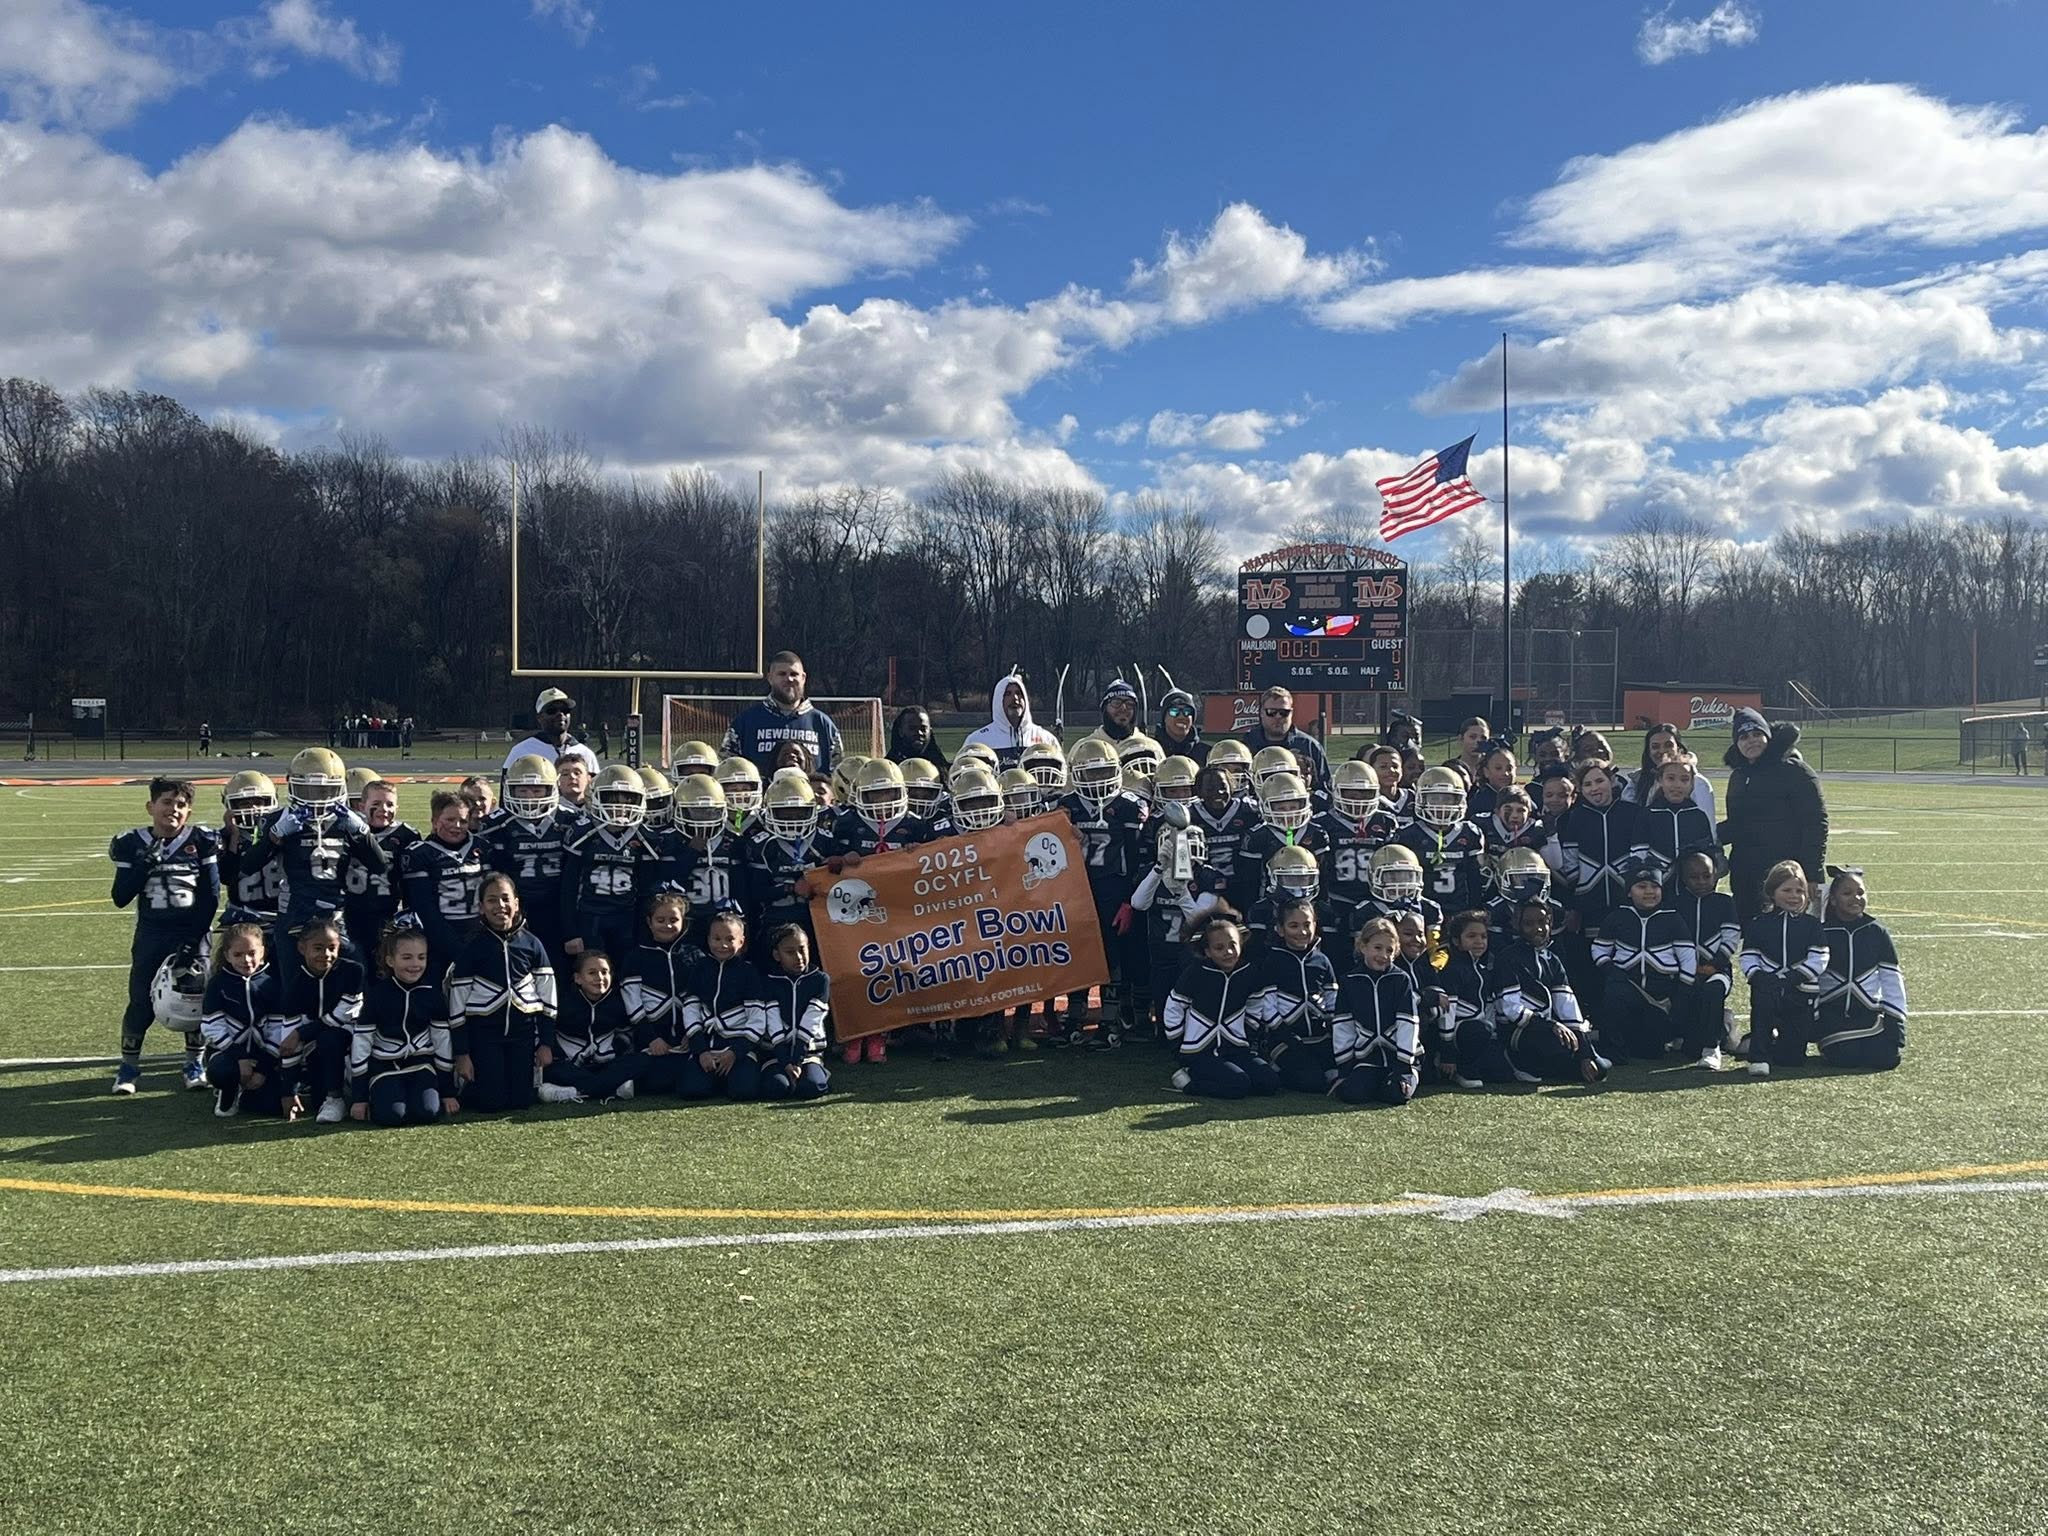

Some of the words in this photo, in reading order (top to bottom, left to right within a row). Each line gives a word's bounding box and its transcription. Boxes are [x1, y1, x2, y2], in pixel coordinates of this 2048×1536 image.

[1241, 640, 1276, 650] MARLBORO
[1371, 639, 1403, 650] GUEST
[1360, 666, 1380, 675] HALF
[1234, 698, 1259, 714] Duke
[1691, 696, 1729, 713] Dukes
[757, 728, 818, 742] NEWBURGH
[919, 845, 977, 874] 2025
[914, 866, 992, 895] OCYFL
[914, 893, 984, 916] Division
[990, 887, 998, 899] 1
[859, 920, 967, 977] Super
[975, 902, 1068, 940] Bowl
[867, 940, 1071, 1005] Champions
[906, 1002, 951, 1015] MEMBER
[953, 1000, 965, 1009] OF
[970, 996, 991, 1006] USA
[991, 983, 1043, 1000] FOOTBALL
